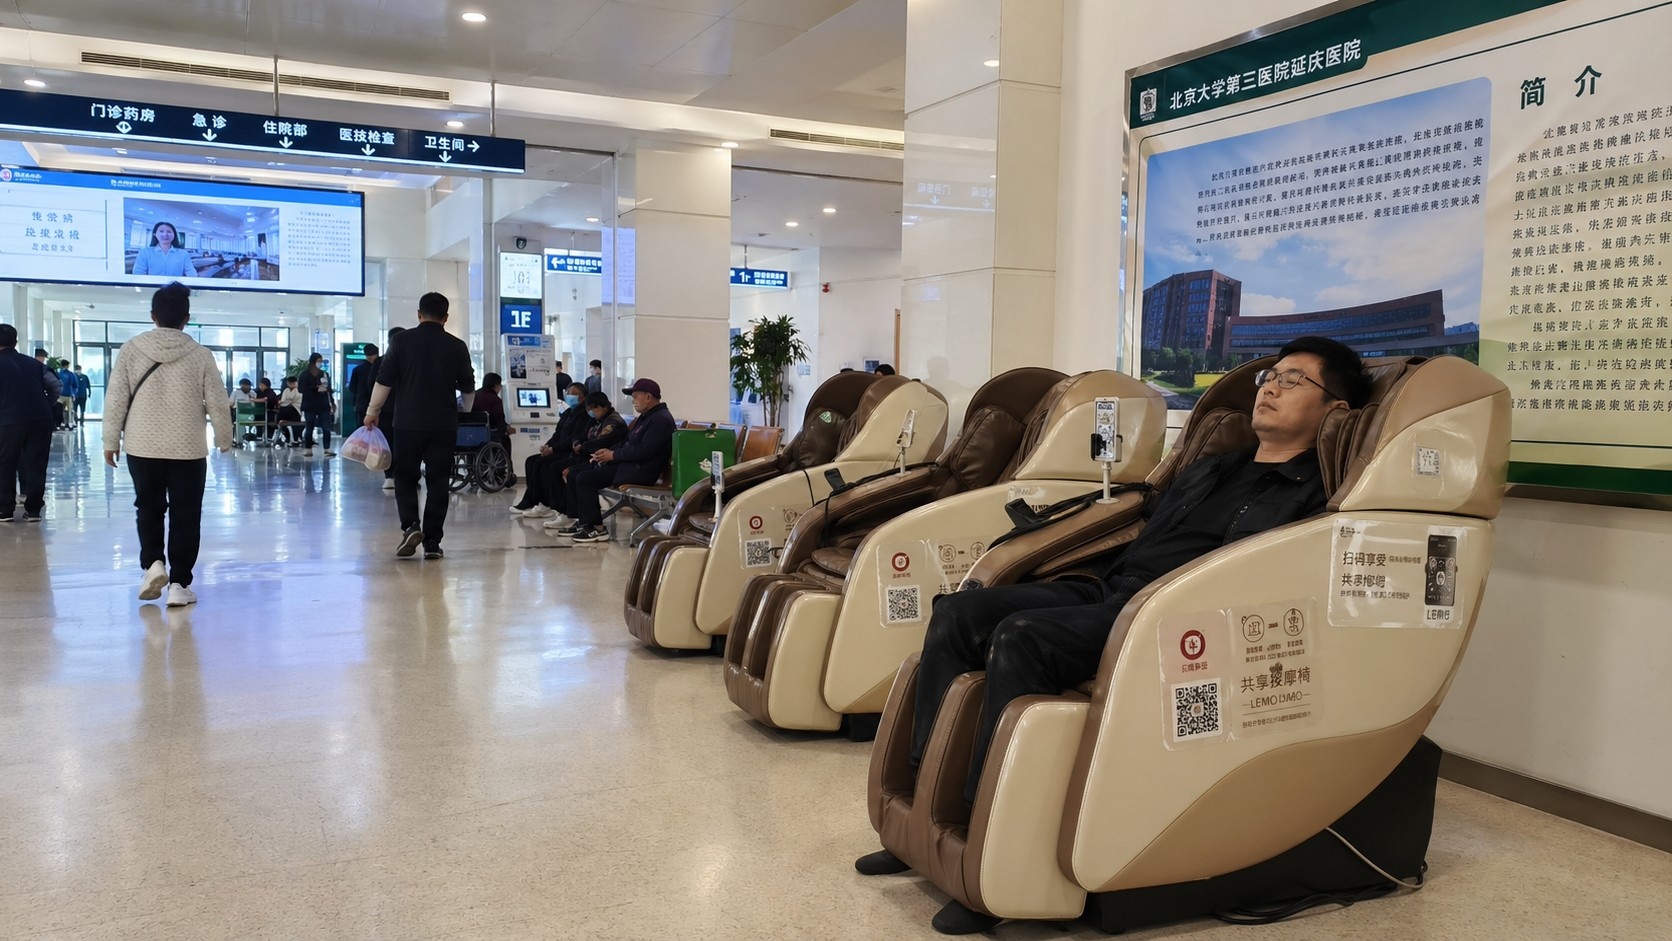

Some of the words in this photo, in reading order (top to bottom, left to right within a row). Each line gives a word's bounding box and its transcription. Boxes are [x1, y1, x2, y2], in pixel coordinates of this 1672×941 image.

[1169, 38, 1362, 110] 北京大学第三医院延庆医院
[1519, 64, 1603, 110] 简介
[90, 102, 156, 123] 门诊药房
[192, 112, 227, 130] 急诊
[262, 120, 308, 138] 住院部
[339, 127, 395, 145] 医技检查
[424, 135, 465, 152] 卫生间
